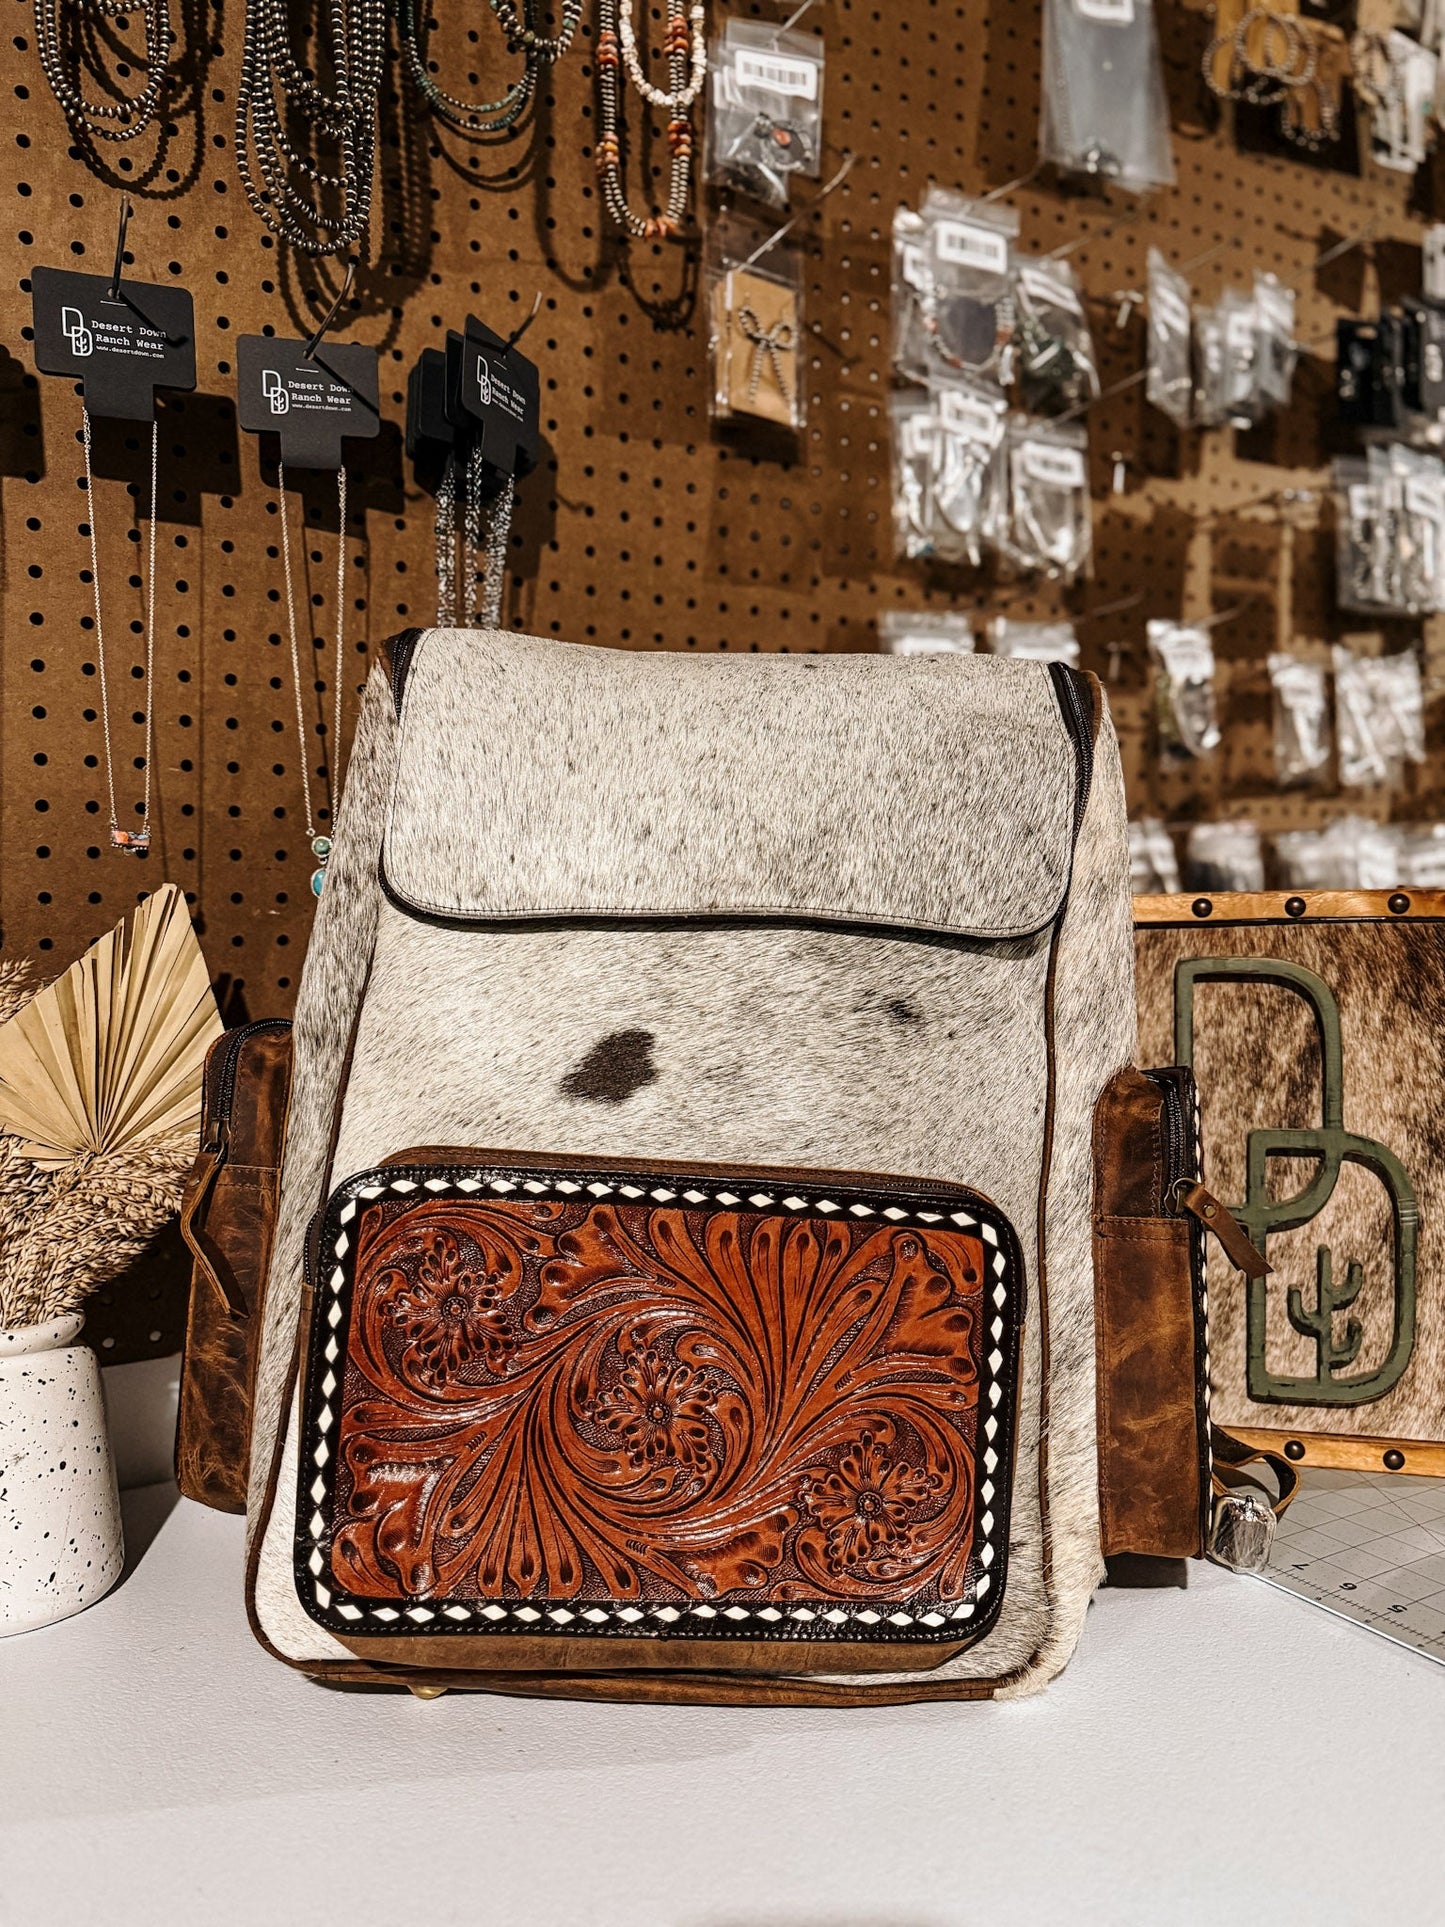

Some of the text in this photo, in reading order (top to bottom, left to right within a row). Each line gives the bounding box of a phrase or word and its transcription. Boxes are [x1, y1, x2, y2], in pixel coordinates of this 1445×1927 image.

[91, 320, 167, 338] Desert Down
[95, 333, 164, 350] Ranch Wear
[96, 345, 164, 358] www.desertdown.com
[288, 380, 324, 391] Desert
[490, 373, 526, 405] Desert Down
[291, 392, 351, 404] Ranch Wear
[492, 386, 509, 404] Ranch
[510, 399, 524, 415] Wear
[1291, 1562, 1309, 1571] 7
[1339, 1582, 1357, 1591] 6
[1387, 1604, 1408, 1613] 5
